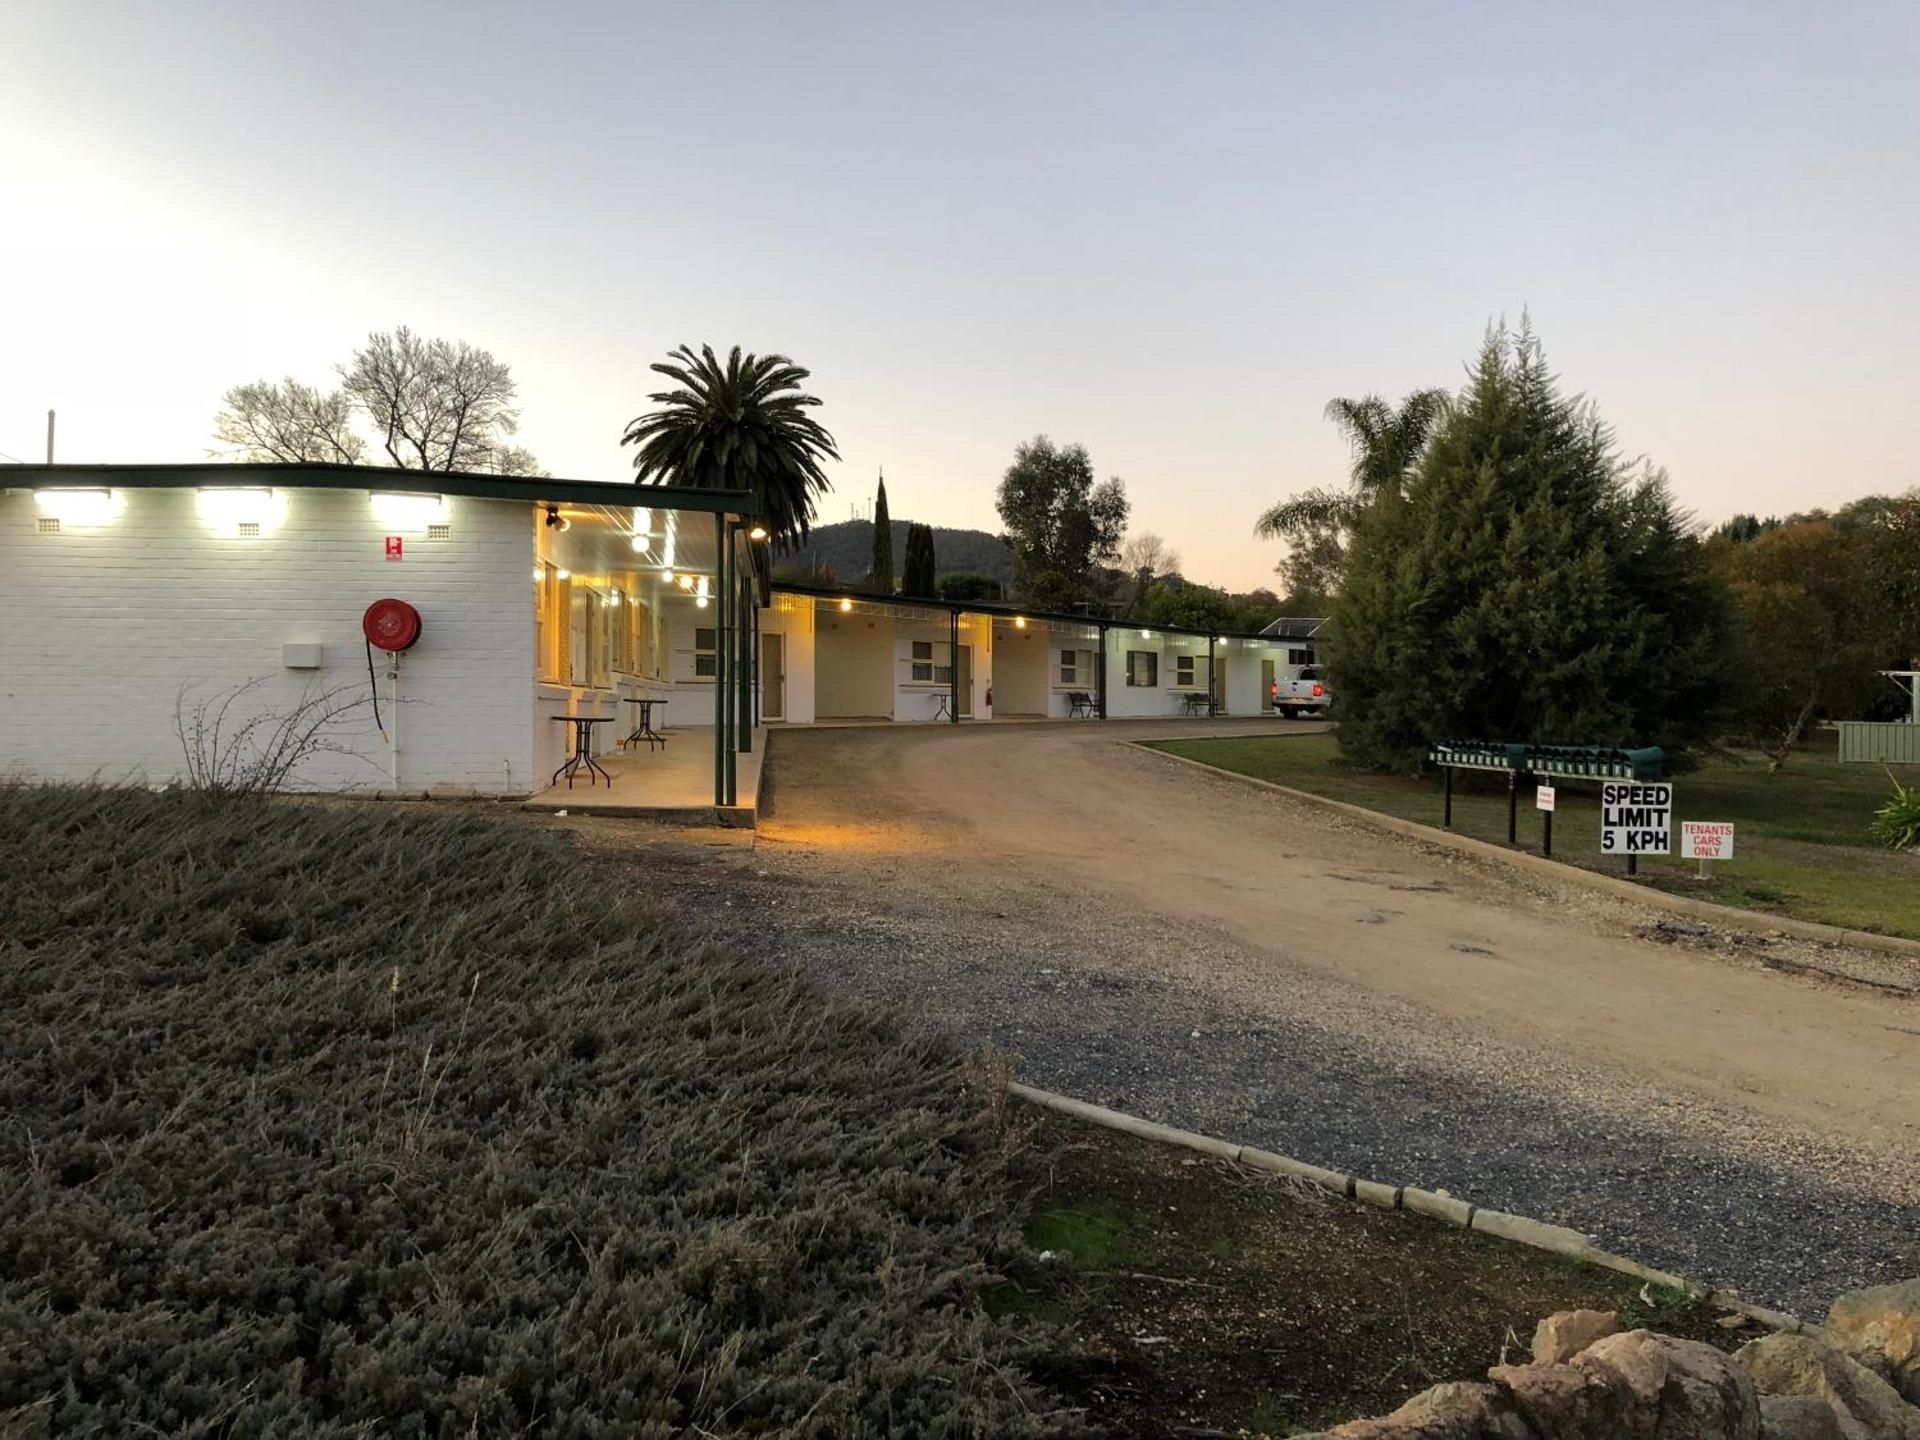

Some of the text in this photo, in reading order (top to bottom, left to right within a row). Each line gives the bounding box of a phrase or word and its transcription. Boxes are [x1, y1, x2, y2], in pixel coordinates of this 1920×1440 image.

[1604, 785, 1670, 805] SPEED
[1604, 807, 1669, 827] LIMIT
[1684, 824, 1732, 836] TENANTS
[1602, 830, 1668, 851] 5 KPH
[1694, 835, 1722, 846] CARS
[1694, 846, 1720, 857] ONLY
